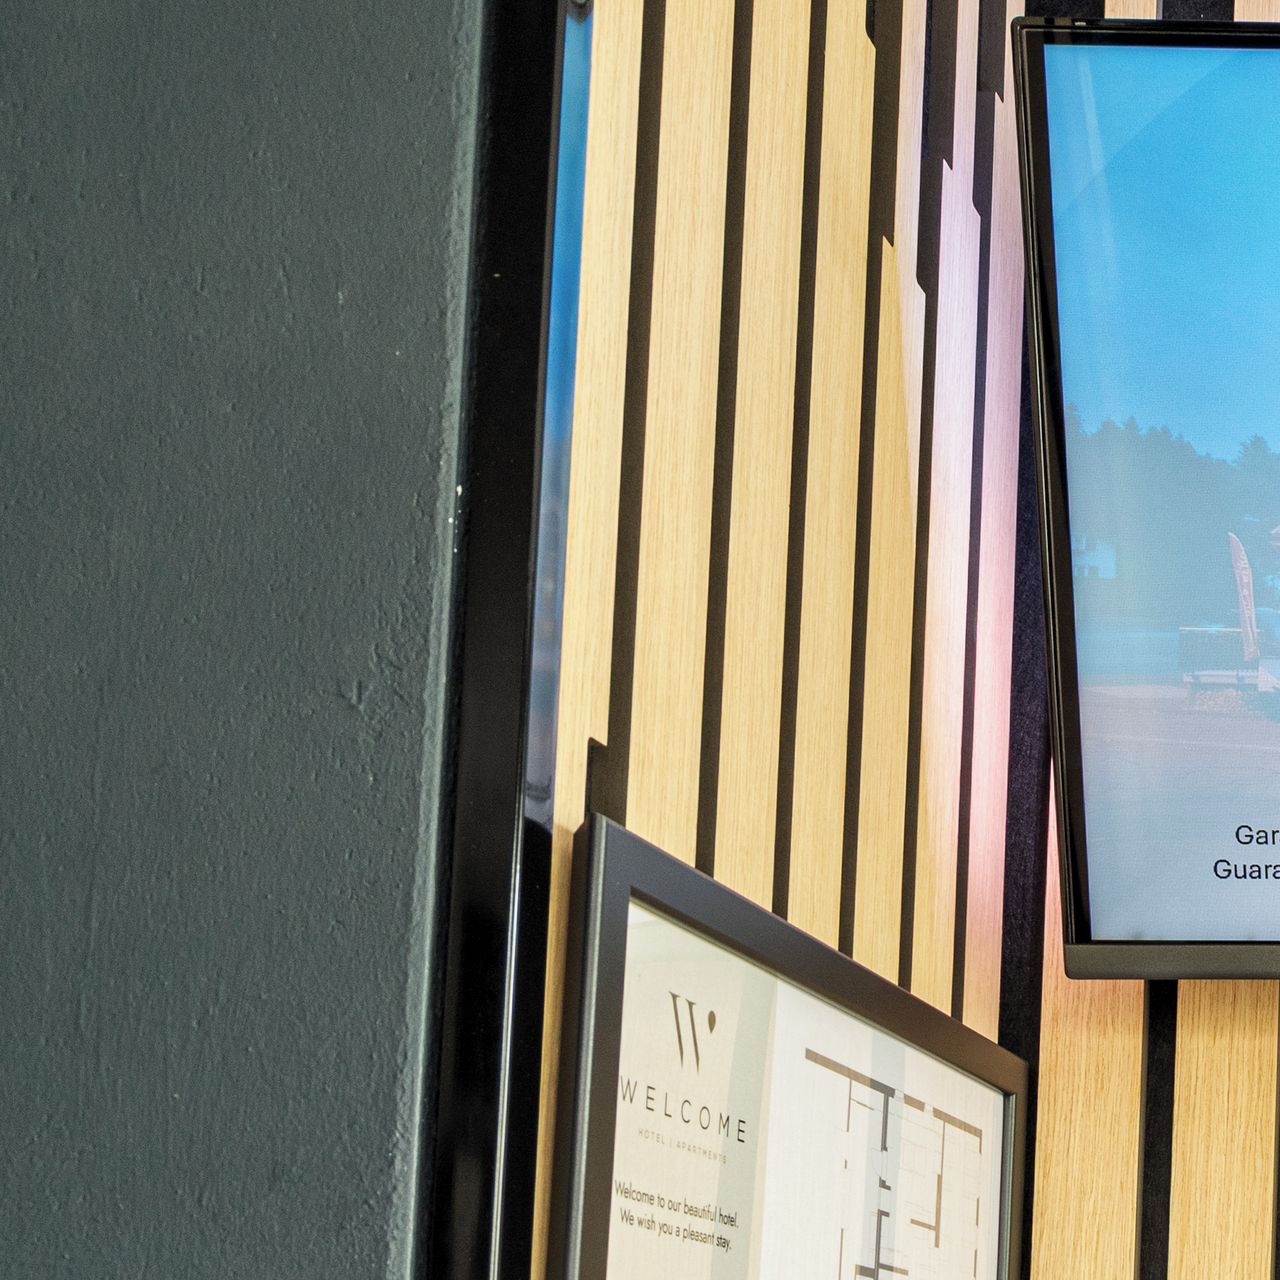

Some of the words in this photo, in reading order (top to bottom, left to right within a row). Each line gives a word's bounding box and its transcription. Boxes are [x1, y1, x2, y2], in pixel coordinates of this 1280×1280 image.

[619, 1074, 747, 1144] WELCOME
[615, 1179, 655, 1206] Welcome
[657, 1193, 666, 1208] to
[667, 1199, 682, 1213] our
[683, 1196, 717, 1222] beautiful
[718, 1207, 739, 1228] hotel.
[620, 1207, 635, 1226] We
[637, 1213, 656, 1231] wish
[658, 1222, 673, 1237] you
[675, 1225, 681, 1237] a
[682, 1223, 715, 1245] pleasant
[716, 1234, 732, 1253] stay.
